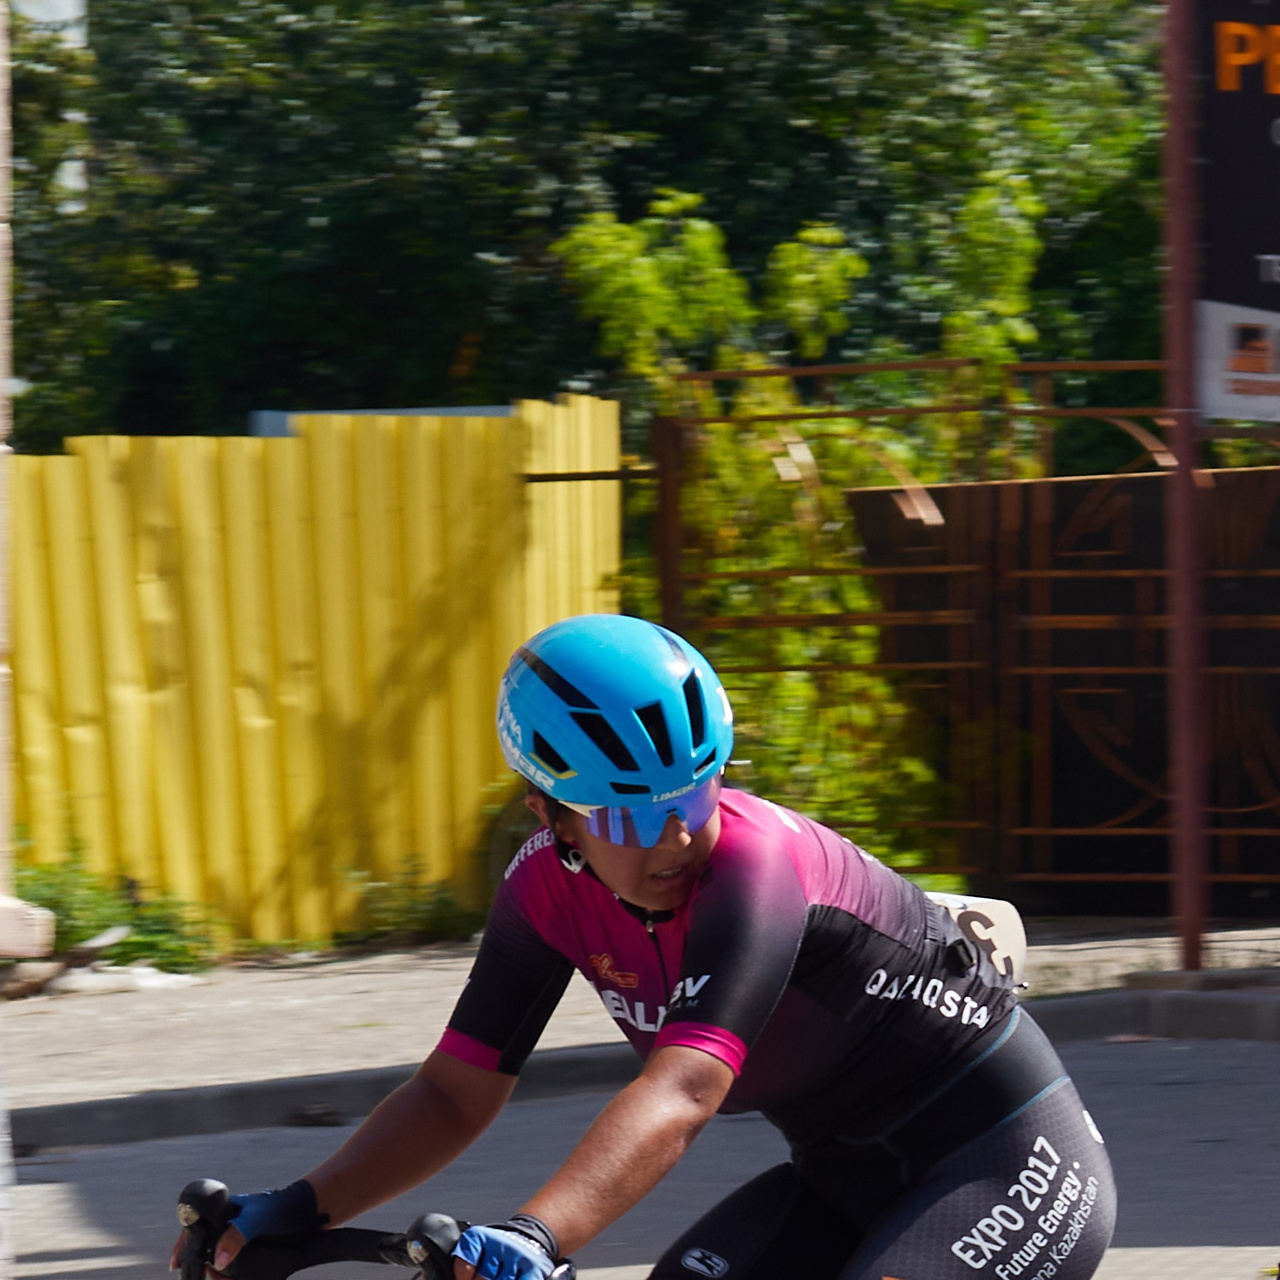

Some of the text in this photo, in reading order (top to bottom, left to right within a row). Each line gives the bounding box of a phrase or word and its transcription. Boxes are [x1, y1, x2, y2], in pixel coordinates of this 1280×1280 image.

[863, 968, 992, 1030] QAZAQSTA
[951, 1135, 1062, 1270] EXPO 2017
[1038, 1170, 1083, 1234] Energy
[1048, 1176, 1099, 1265] Kazakhstan
